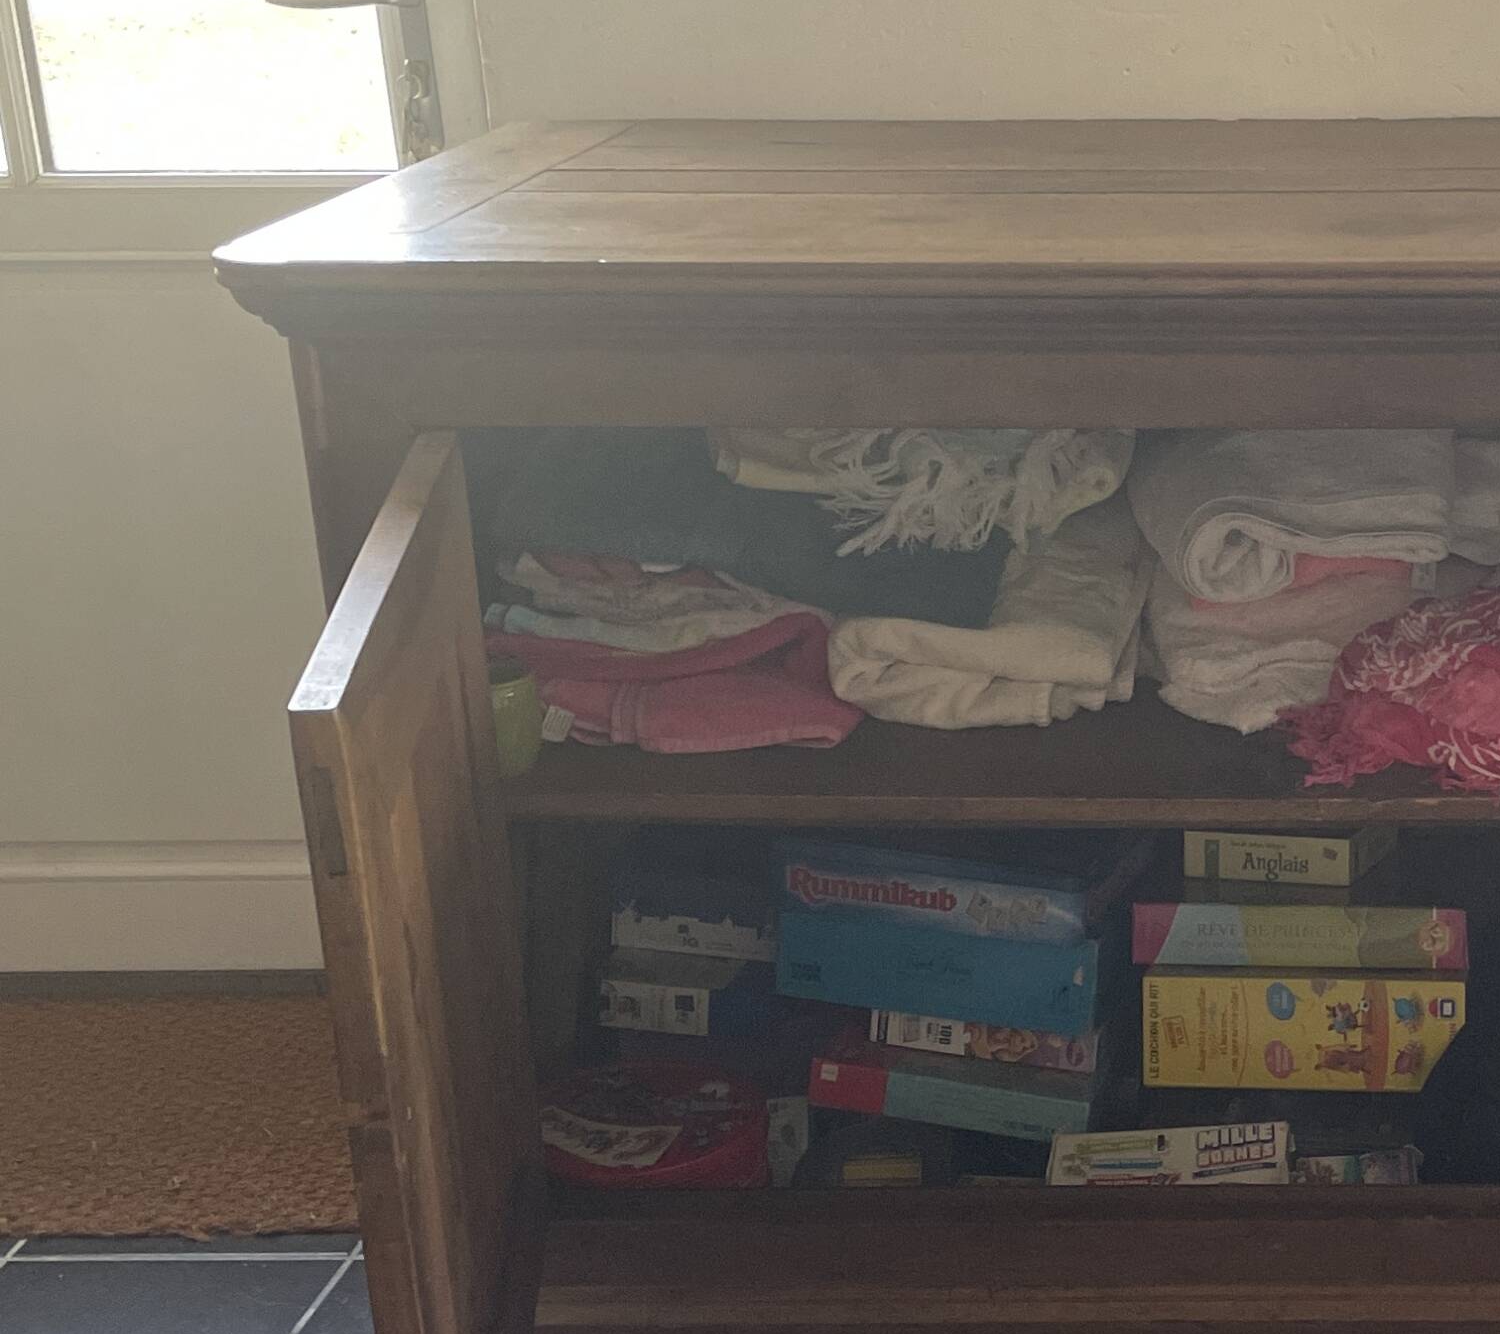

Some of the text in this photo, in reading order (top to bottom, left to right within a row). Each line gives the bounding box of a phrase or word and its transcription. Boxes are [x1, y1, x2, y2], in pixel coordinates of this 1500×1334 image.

[1242, 851, 1309, 880] Anglais
[788, 865, 958, 913] Rummikub
[938, 1024, 952, 1046] 100
[1148, 983, 1161, 1079] LE COCHON QUI RIT
[1197, 1123, 1275, 1150] MILLE
